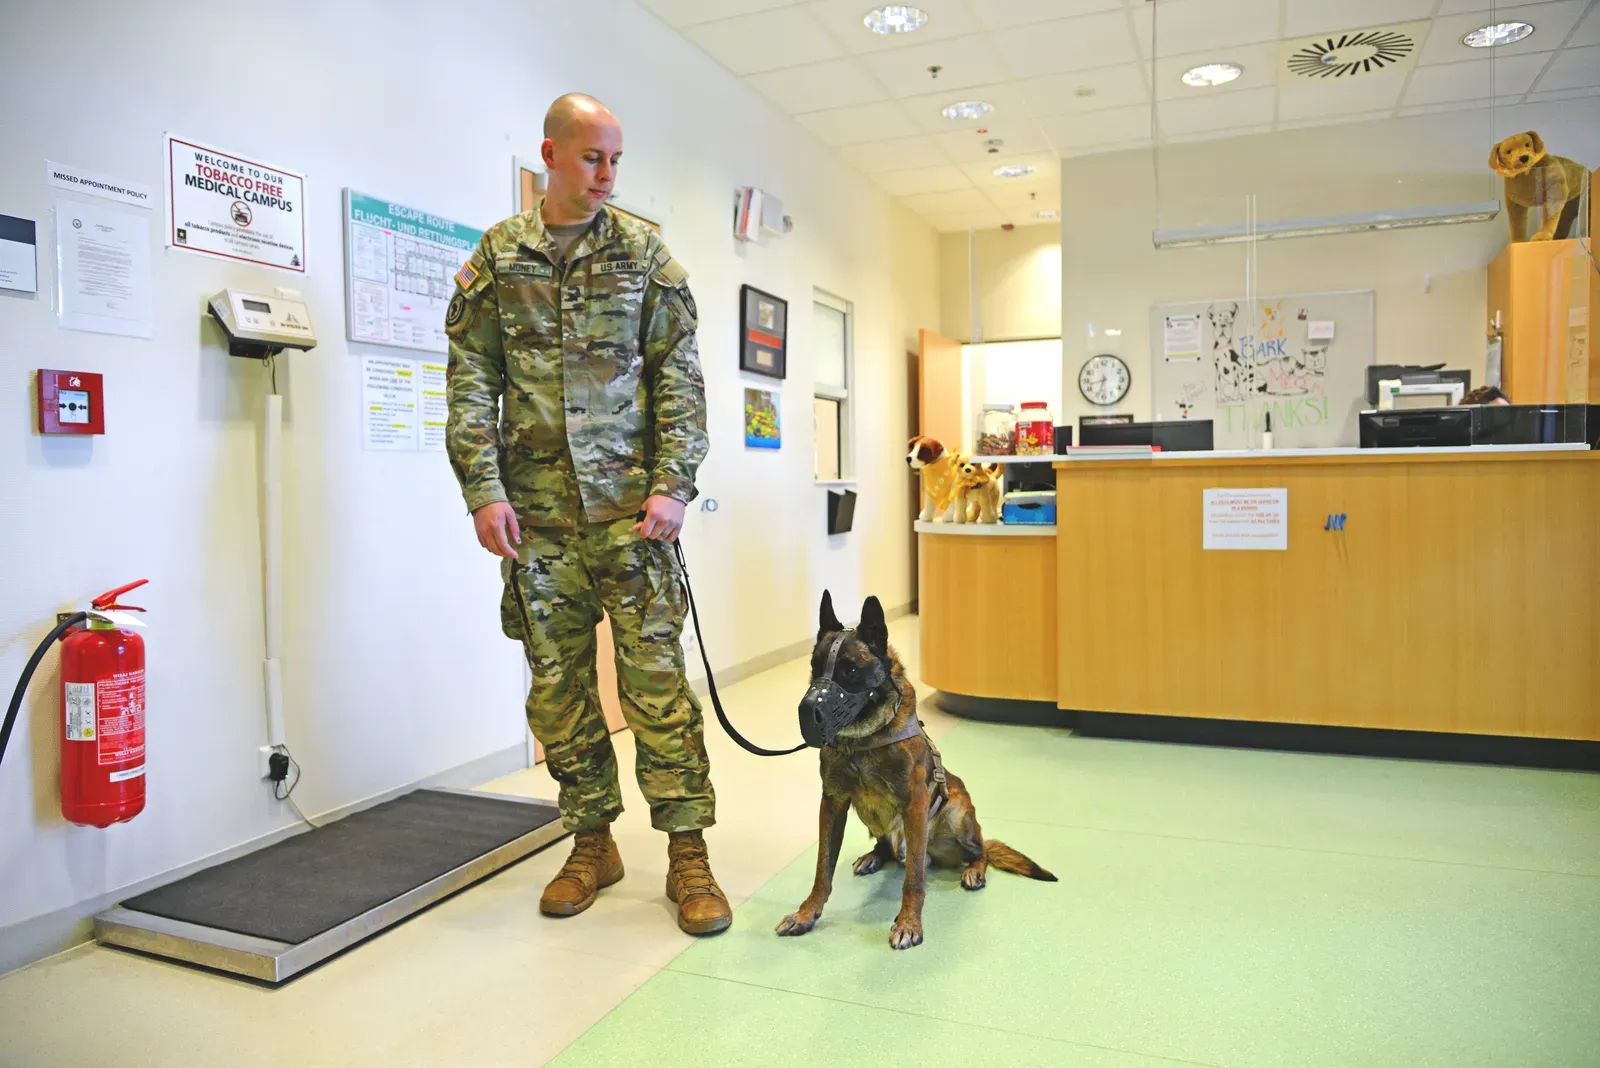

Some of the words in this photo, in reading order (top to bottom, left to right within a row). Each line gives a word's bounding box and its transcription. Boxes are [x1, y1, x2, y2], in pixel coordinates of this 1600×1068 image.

[195, 152, 245, 174] WELCOME
[248, 168, 260, 178] TO
[264, 173, 283, 184] OUR
[195, 163, 253, 190] TOBACCO
[255, 181, 283, 198] FREE
[53, 172, 78, 183] MISSED
[79, 179, 126, 195] APPOINTMENT
[126, 189, 147, 199] POLICY
[185, 173, 241, 199] MEDICAL
[243, 190, 293, 212] CAMPUS
[354, 209, 396, 228] FLUCHT-
[397, 221, 416, 235] UND
[419, 227, 478, 251] RETTUNGSPLA
[388, 204, 425, 224] ESCAPE
[426, 213, 455, 233] ROUTE
[600, 263, 613, 272] US
[615, 261, 638, 270] ARMY
[1240, 336, 1287, 360] BARK
[1221, 396, 1329, 432] THANKS!
